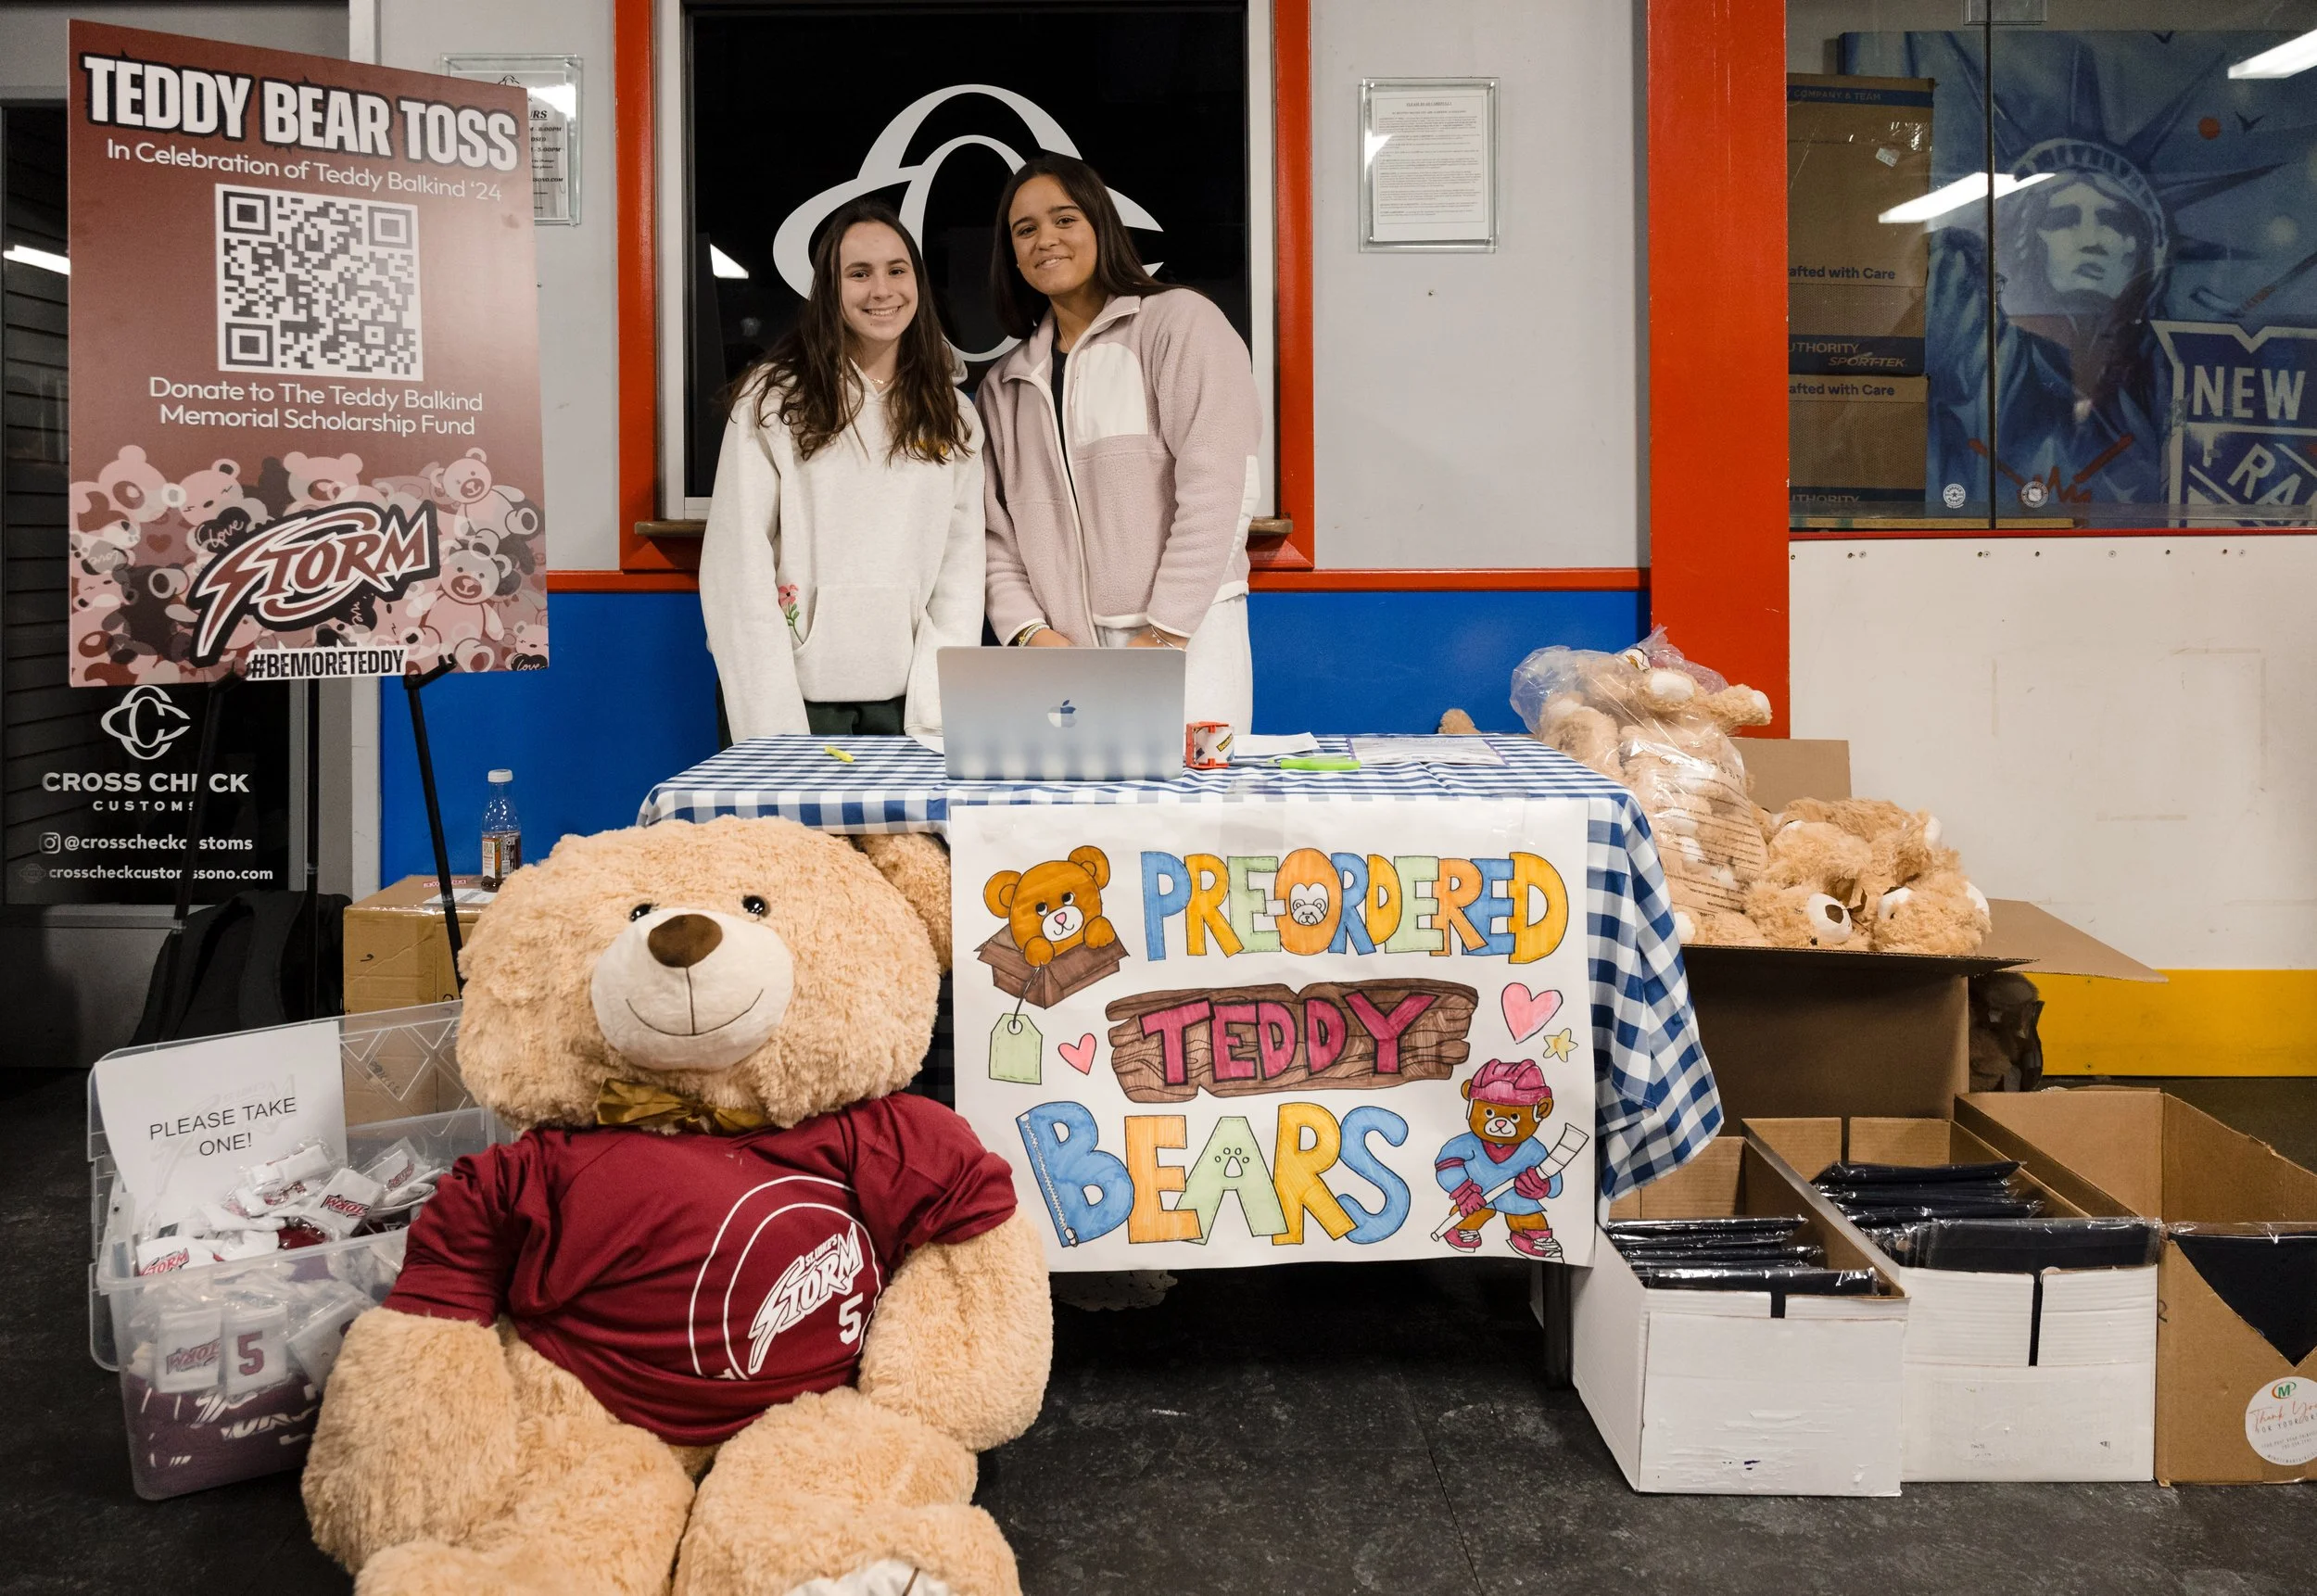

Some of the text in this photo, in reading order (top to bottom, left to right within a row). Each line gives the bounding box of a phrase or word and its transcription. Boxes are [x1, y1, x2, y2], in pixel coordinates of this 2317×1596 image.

[83, 56, 518, 171] TEDDY BEAR TOSS
[108, 138, 130, 160] In
[135, 142, 279, 176] Celebration
[284, 160, 310, 181] of
[313, 163, 383, 192] Teddy
[387, 171, 465, 197] Balkind
[1789, 265, 1895, 279] afted with Care
[149, 376, 483, 412] Donate to The Teddy Balkind
[1789, 383, 1895, 396] afted with Care
[2192, 364, 2306, 421] NEW
[159, 403, 475, 437] Memorial Scholarship Fund
[194, 505, 433, 659] STORM
[250, 648, 405, 678] #BEMORETEDDY
[42, 772, 142, 792] CROSS
[64, 833, 253, 851] @crosscheckcstoms
[1136, 989, 1439, 1087] TEDDY
[149, 1096, 297, 1140] PLEASE TAKE
[199, 1132, 252, 1156] ONE!
[1015, 1100, 1412, 1248] BEARS
[747, 1221, 865, 1375] STORM
[839, 1292, 864, 1345] 5
[236, 1330, 265, 1376] 5
[2248, 1404, 2285, 1433] Thank
